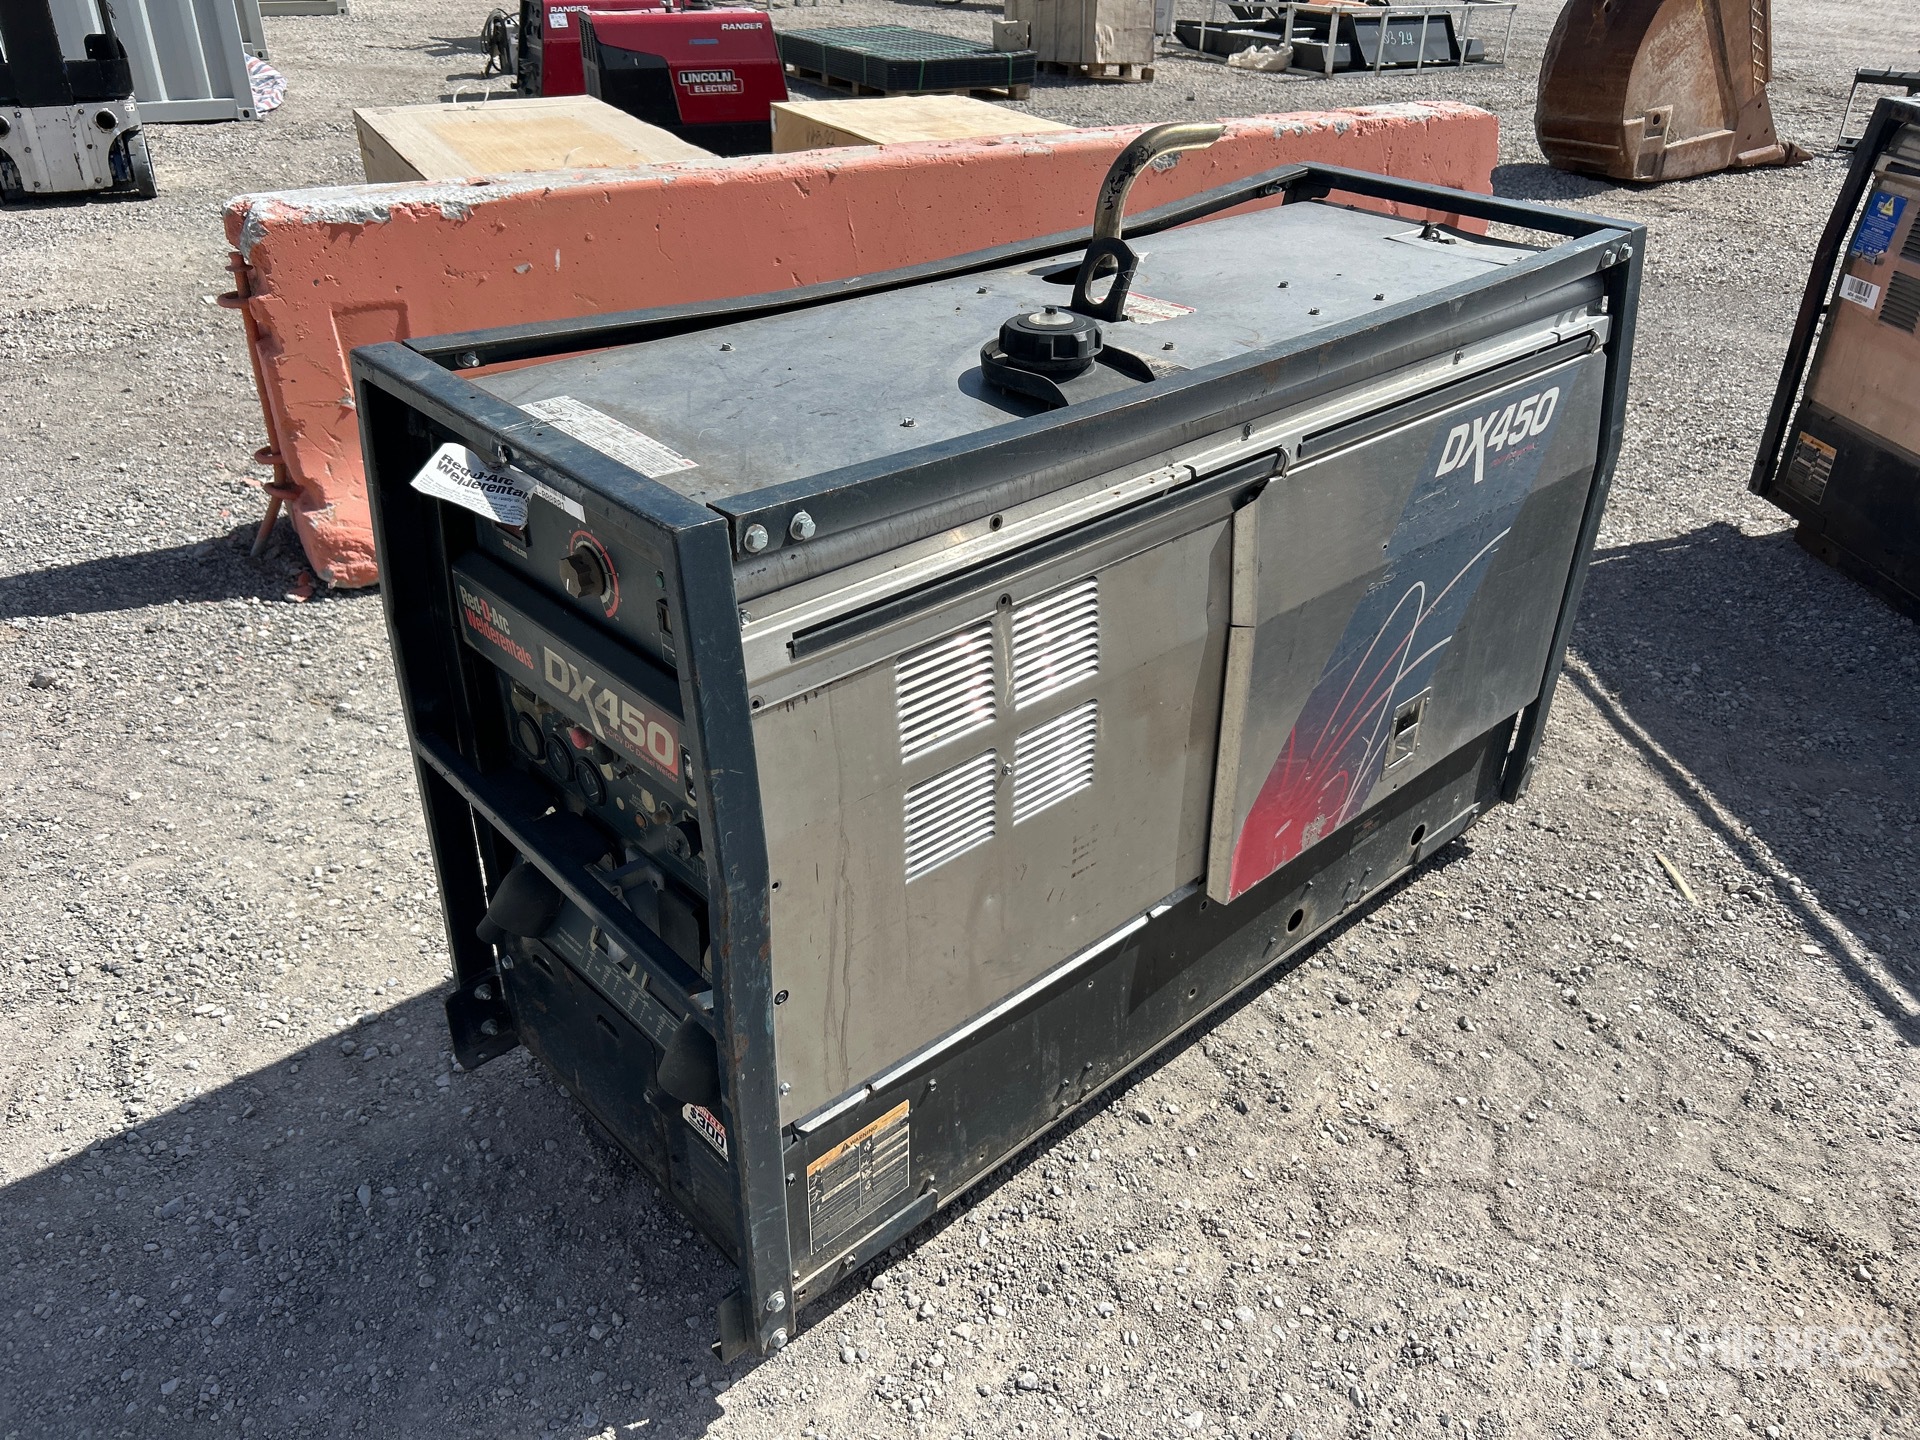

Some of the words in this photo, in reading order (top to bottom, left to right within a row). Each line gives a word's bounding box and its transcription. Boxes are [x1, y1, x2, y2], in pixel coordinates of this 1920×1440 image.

[721, 22, 763, 31] RANGER
[681, 71, 732, 84] LINCOLN
[693, 83, 738, 93] ELECTRIC
[1435, 386, 1560, 485] DX450
[459, 584, 511, 636] Red-D-Arc
[464, 606, 534, 670] Welderentals
[544, 646, 675, 768] DX450
[624, 740, 635, 753] DC
[636, 748, 656, 768] Diesel
[656, 762, 679, 783] Welder
[690, 1107, 725, 1149] $300
[850, 1124, 878, 1146] WARNING
